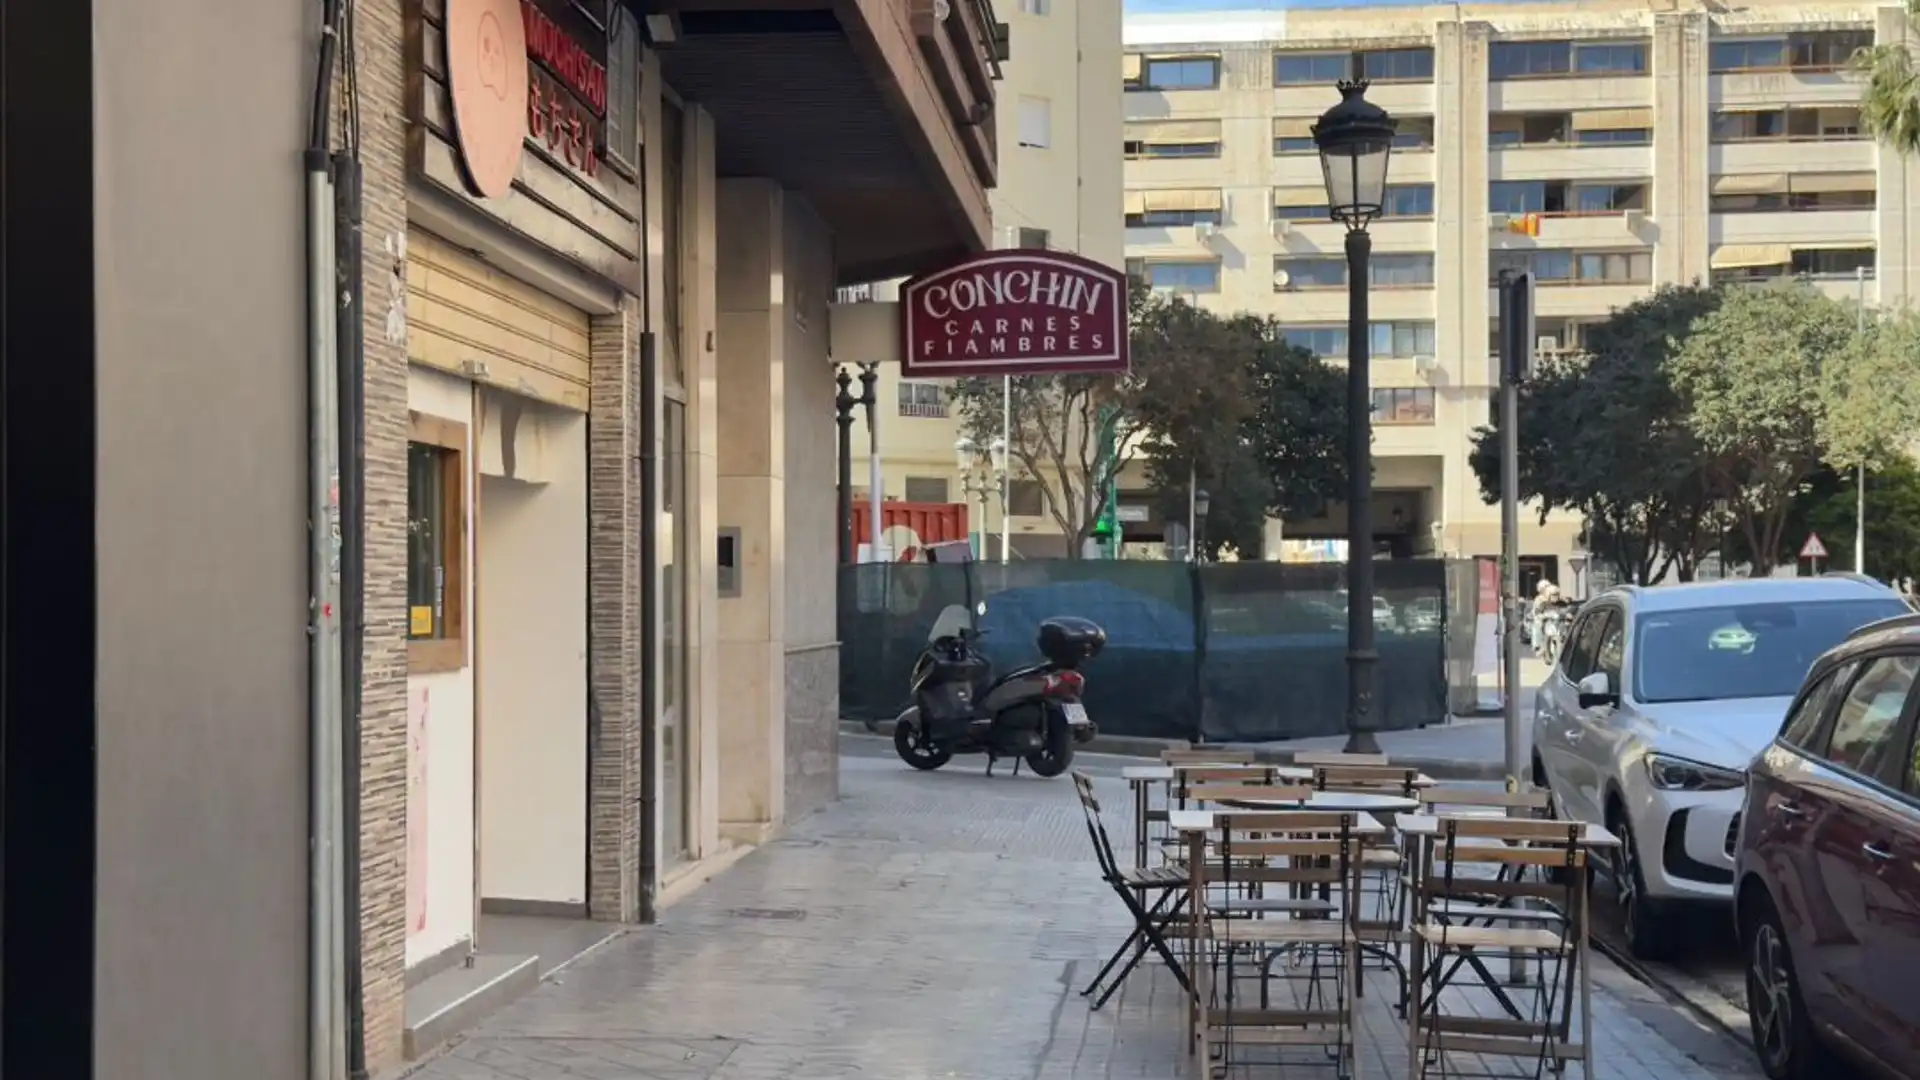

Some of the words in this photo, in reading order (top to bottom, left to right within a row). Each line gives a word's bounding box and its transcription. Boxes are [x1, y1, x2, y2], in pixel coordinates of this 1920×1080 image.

[528, 3, 605, 115] MOCHISAN
[531, 76, 598, 176] もちさん
[924, 269, 1103, 318] CONCHIN
[924, 334, 1103, 355] FIAMBRES
[944, 316, 1080, 336] CARNES
